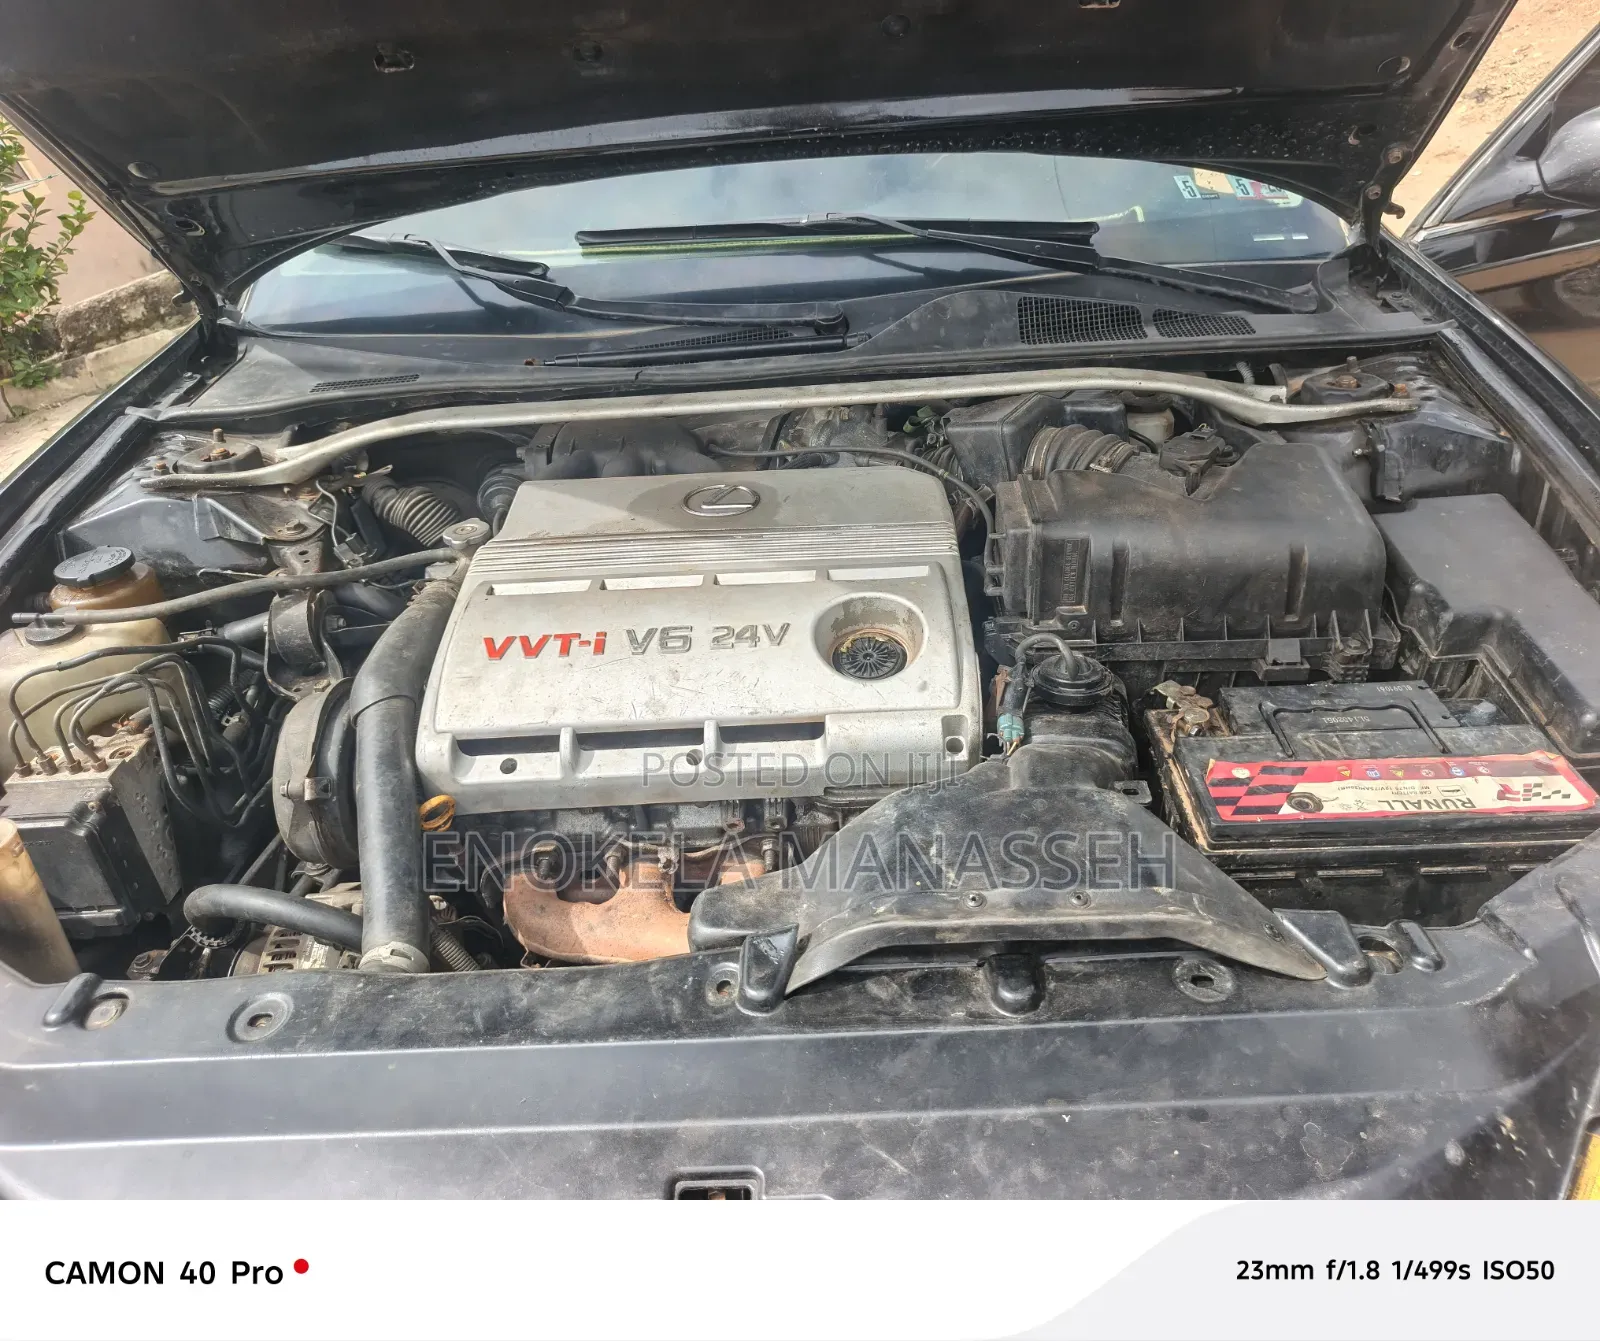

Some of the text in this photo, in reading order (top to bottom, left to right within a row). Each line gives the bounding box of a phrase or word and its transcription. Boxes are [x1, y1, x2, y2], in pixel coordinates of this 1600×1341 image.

[483, 622, 791, 661] VVT-i V6 24V
[1377, 797, 1477, 811] RUNALL
